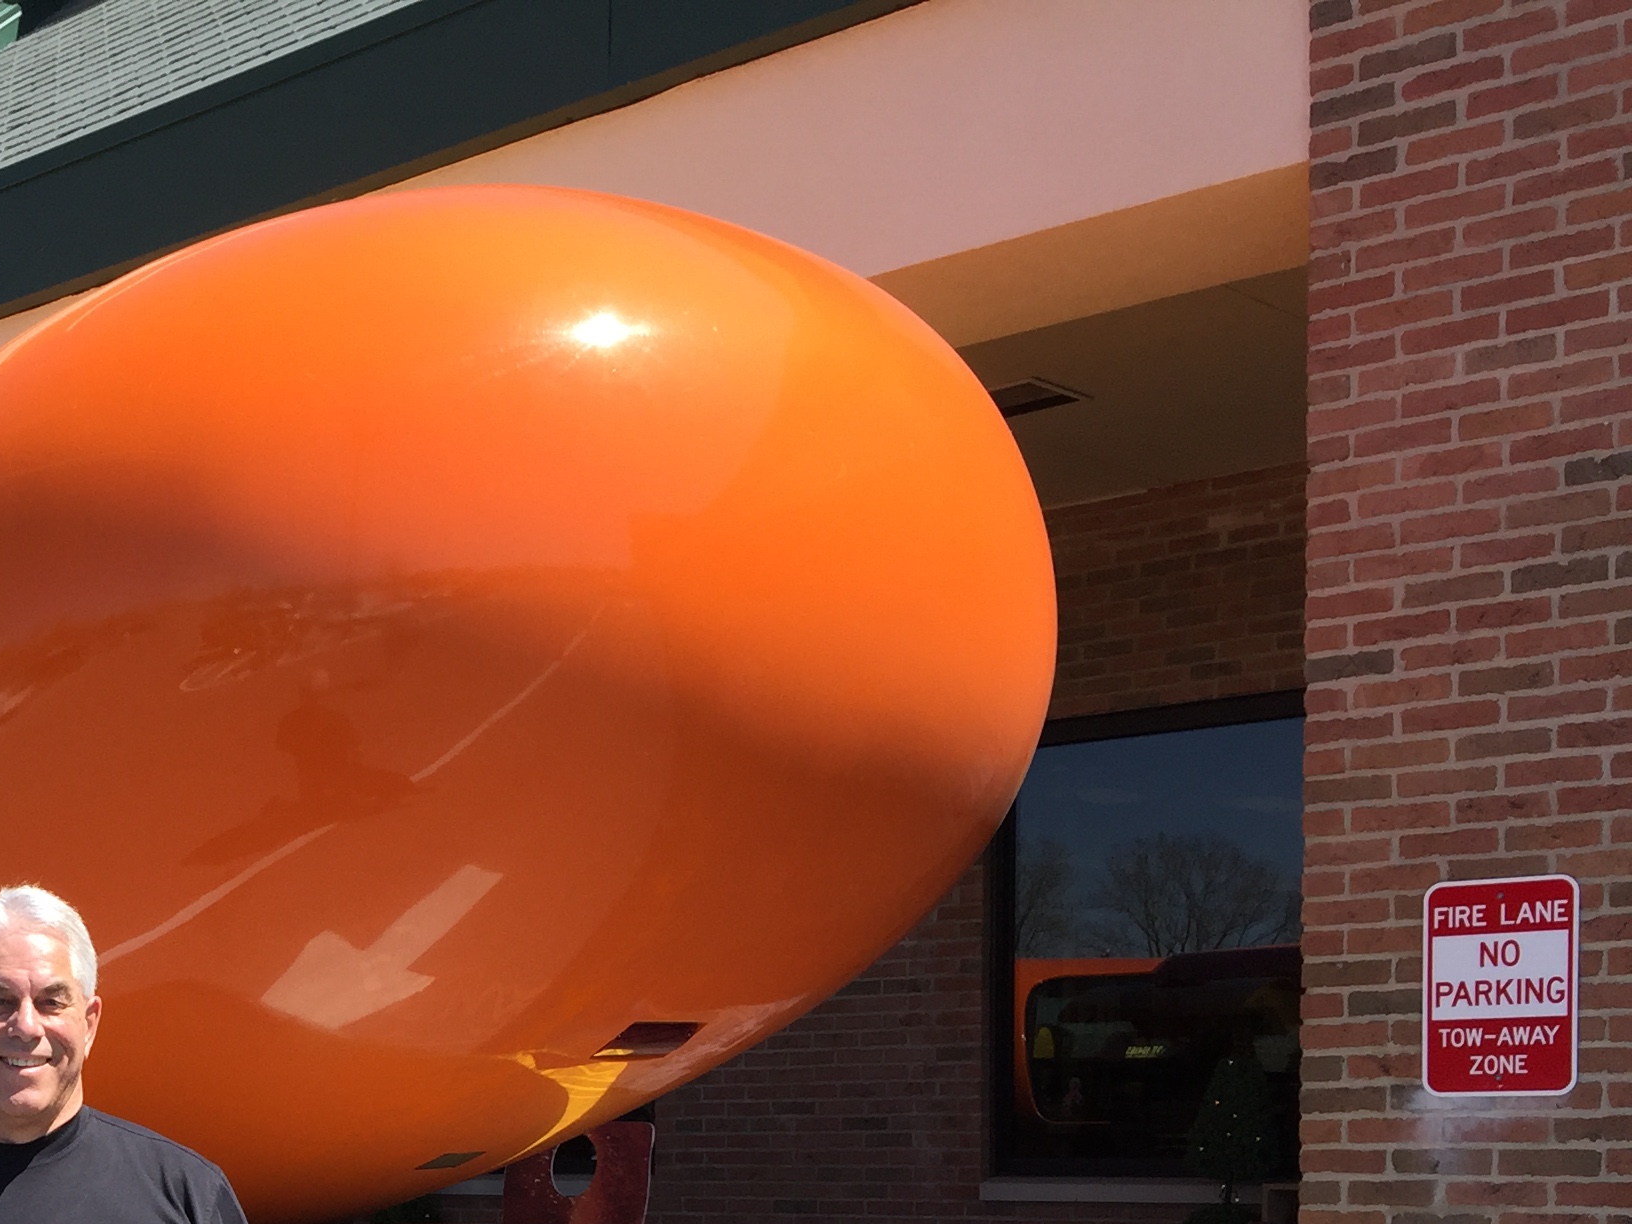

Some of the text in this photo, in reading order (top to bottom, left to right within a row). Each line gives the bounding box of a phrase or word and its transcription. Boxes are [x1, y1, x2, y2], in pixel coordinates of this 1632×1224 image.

[1433, 900, 1568, 929] FIRE LANE
[1479, 939, 1521, 967] NO
[1435, 976, 1566, 1008] PARKING
[1439, 1024, 1560, 1048] TOW-AWAY
[1469, 1054, 1528, 1075] ZONE
